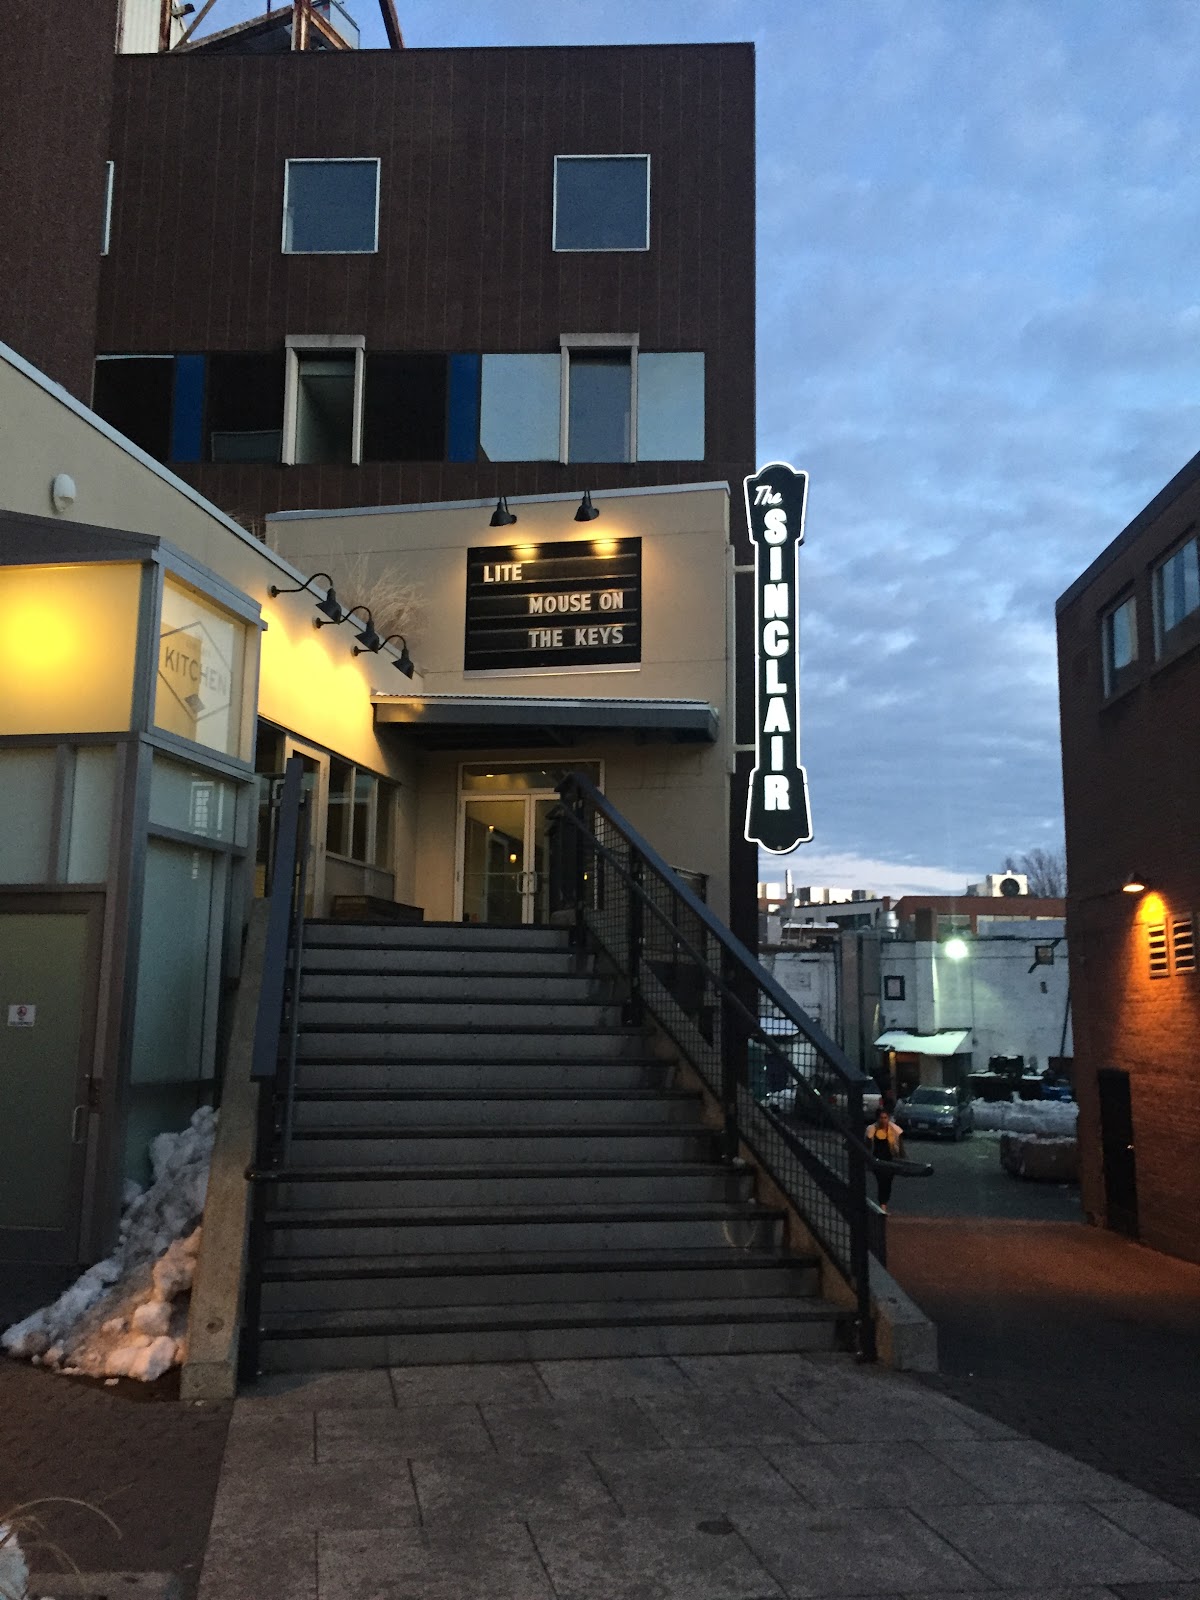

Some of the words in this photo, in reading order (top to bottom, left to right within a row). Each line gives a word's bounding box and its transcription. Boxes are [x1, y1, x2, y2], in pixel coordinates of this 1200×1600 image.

[753, 485, 782, 506] The
[483, 563, 522, 583] LITE
[529, 593, 592, 614] MOUSE
[600, 591, 624, 610] ON
[528, 629, 563, 648] THE
[575, 626, 624, 646] KEYS
[164, 646, 229, 696] KITCHEN
[763, 508, 791, 812] SINCLAIR
